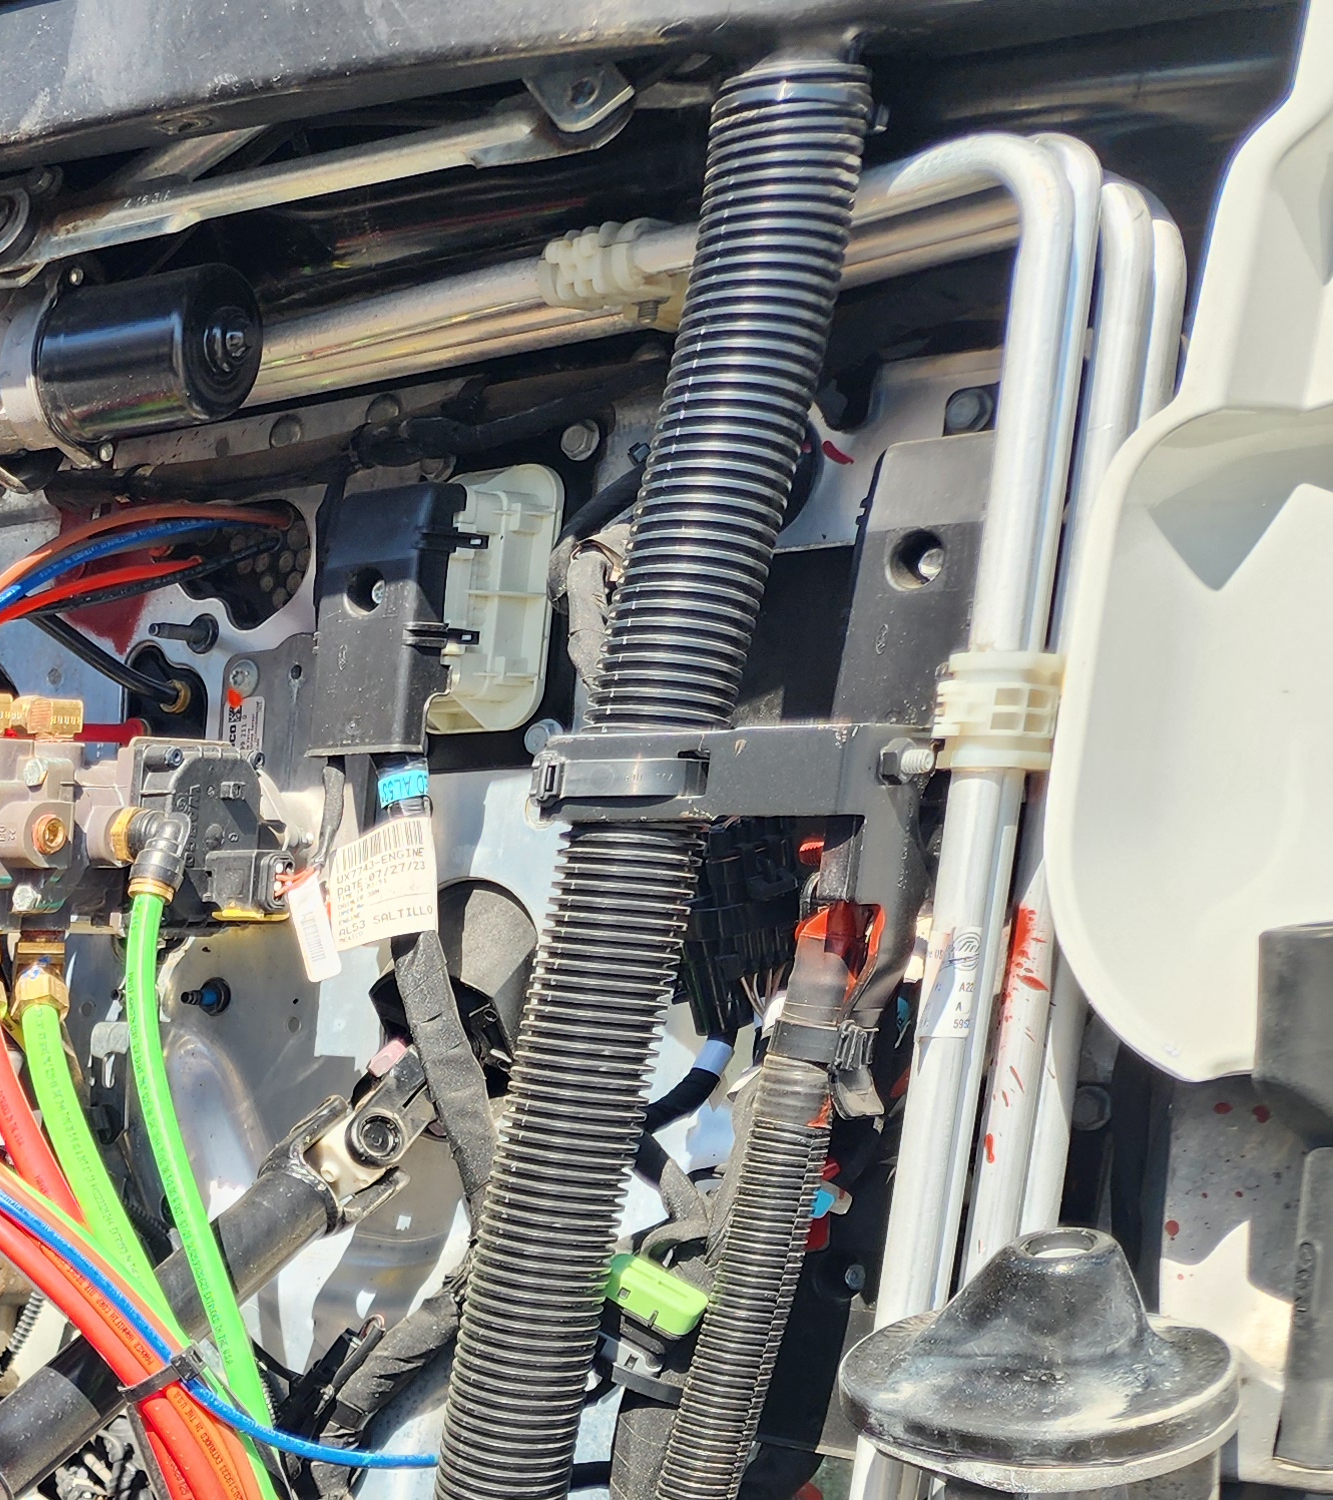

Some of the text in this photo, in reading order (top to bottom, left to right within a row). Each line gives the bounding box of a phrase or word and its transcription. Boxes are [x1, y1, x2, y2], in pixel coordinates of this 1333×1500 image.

[337, 847, 425, 884] UX7743-ENGINE
[339, 905, 433, 937] AL53 SALTILLO
[130, 1340, 157, 1367] PARKER
[187, 1409, 197, 1423] THE
[201, 1431, 224, 1466] EXTRUDED
